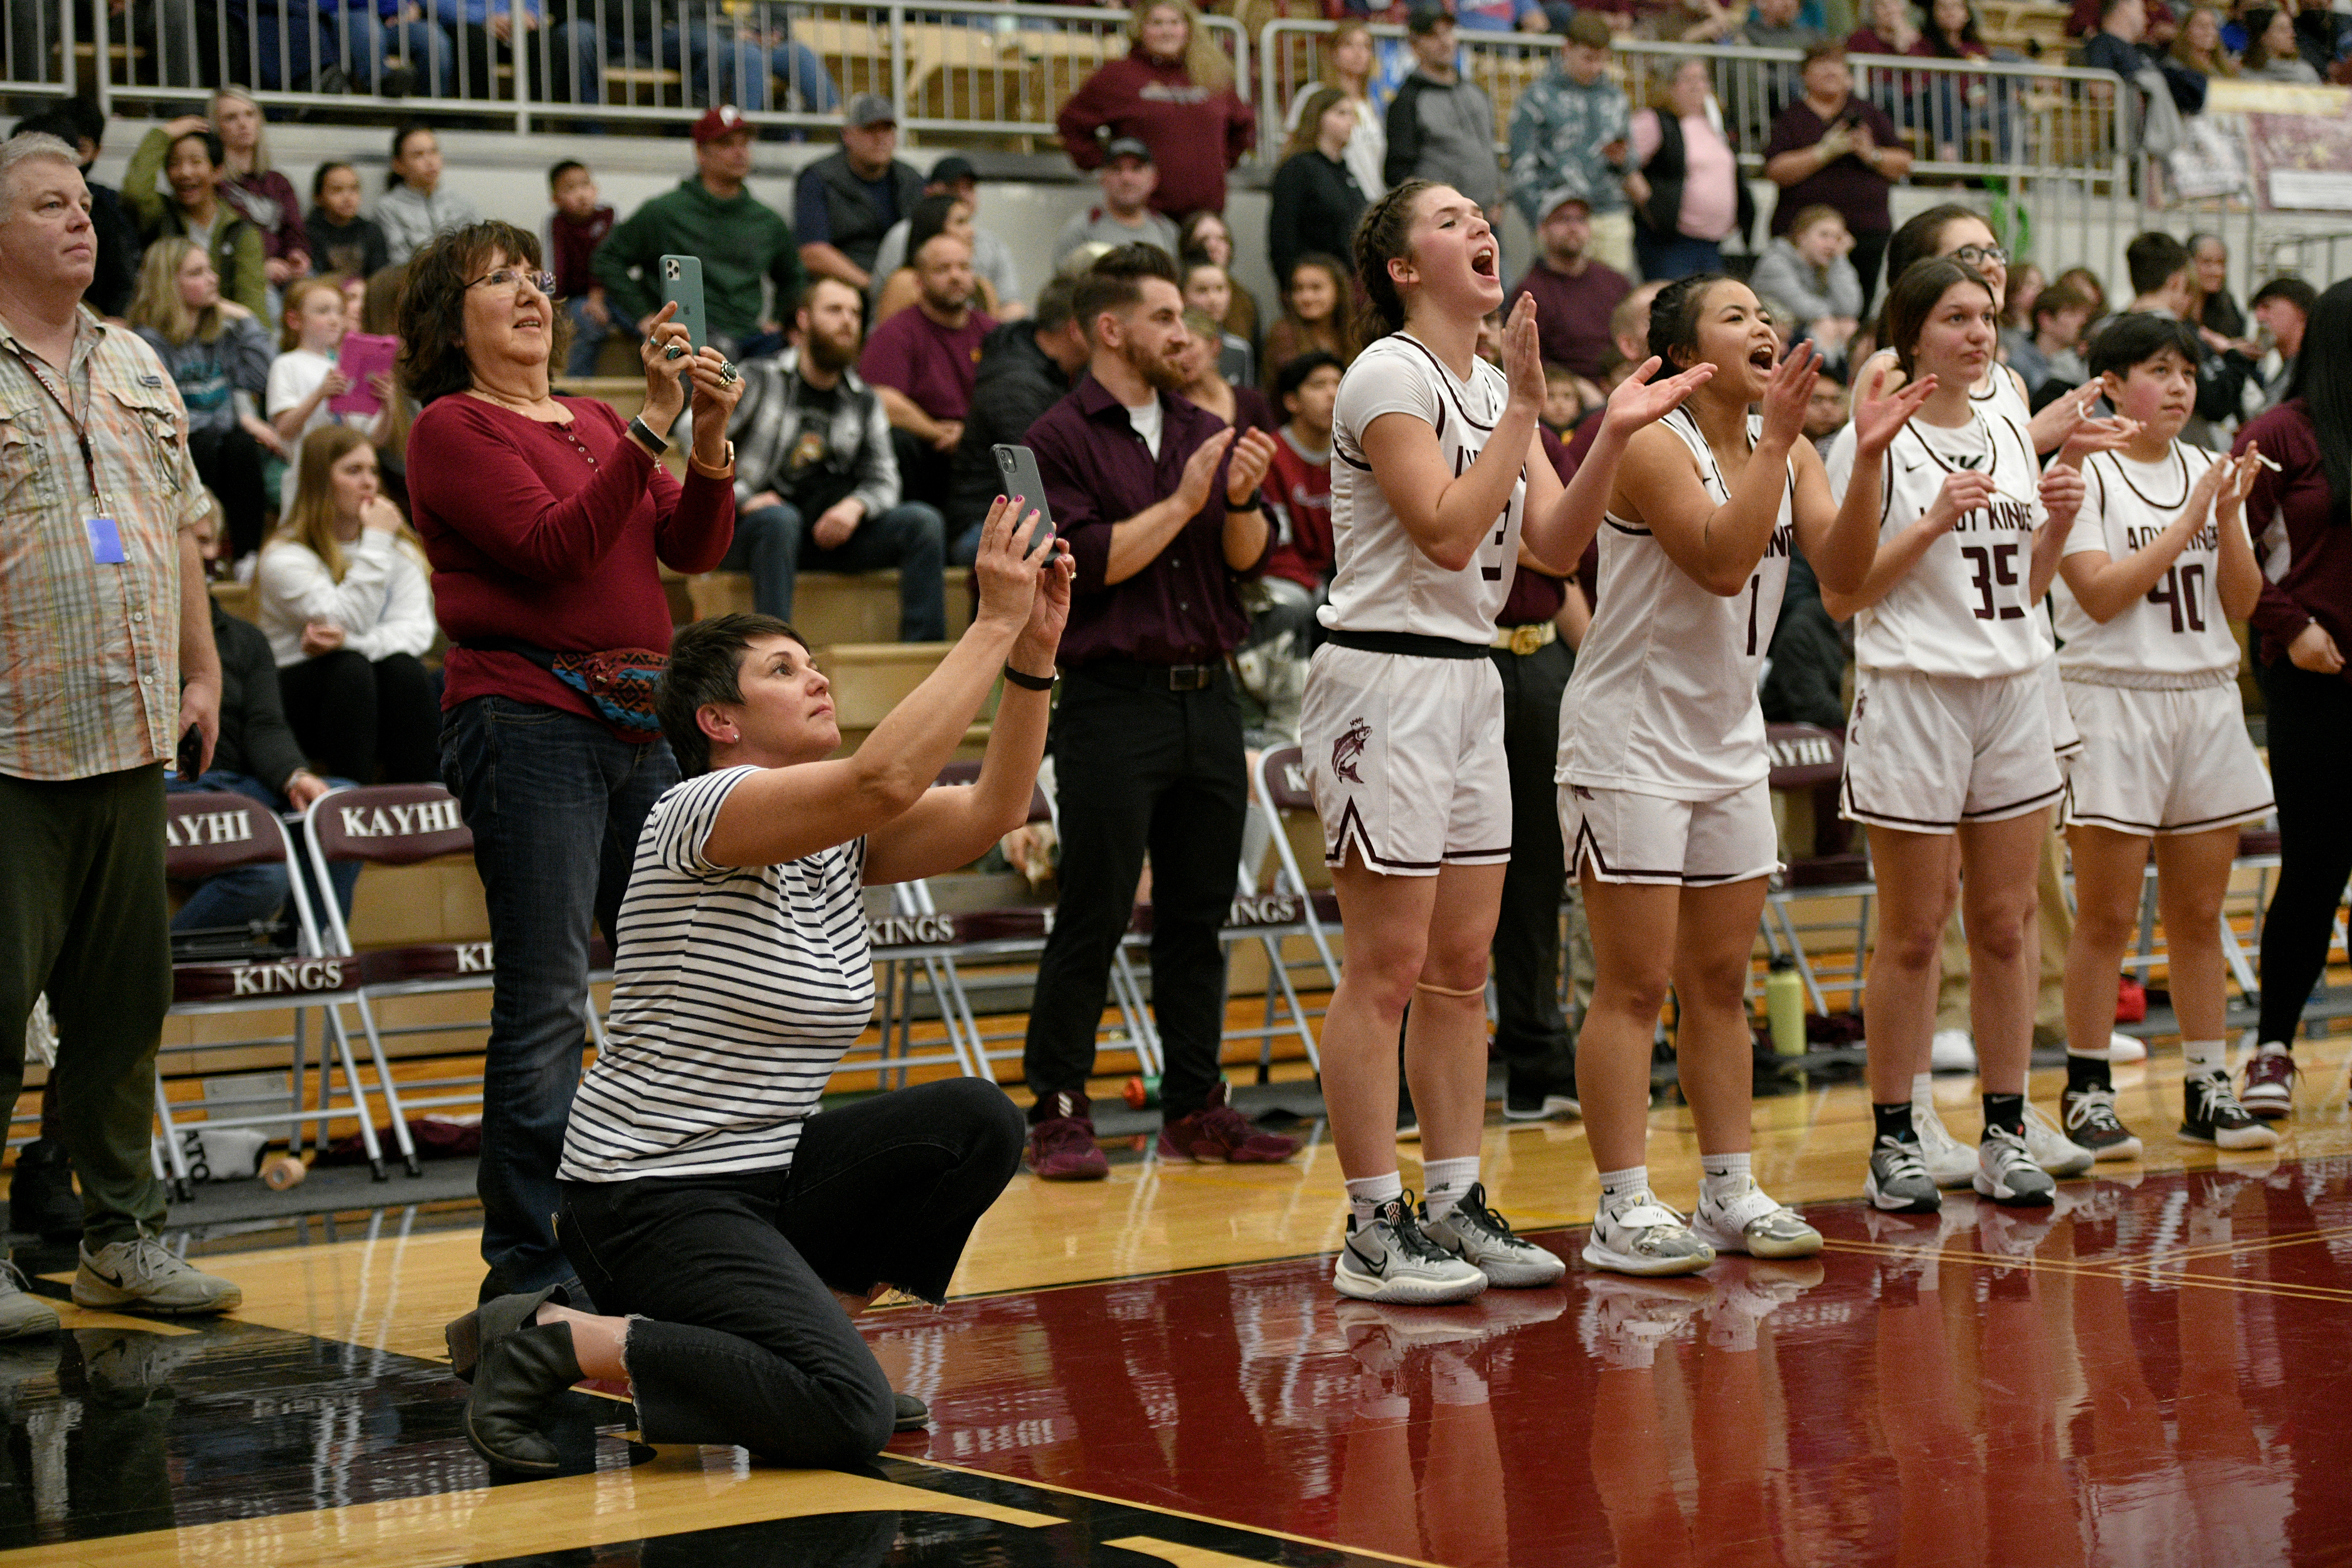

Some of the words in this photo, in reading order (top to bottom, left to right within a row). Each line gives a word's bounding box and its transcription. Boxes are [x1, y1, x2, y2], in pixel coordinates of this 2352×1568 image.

[1961, 544, 2025, 620] 35
[2148, 564, 2205, 633] 40
[1768, 738, 1834, 767] AYHI
[166, 809, 252, 846] AYHI
[340, 798, 461, 837] KAYHI
[868, 914, 955, 945] KINGS
[1224, 896, 1296, 927] INGS
[232, 960, 344, 996] KINGS
